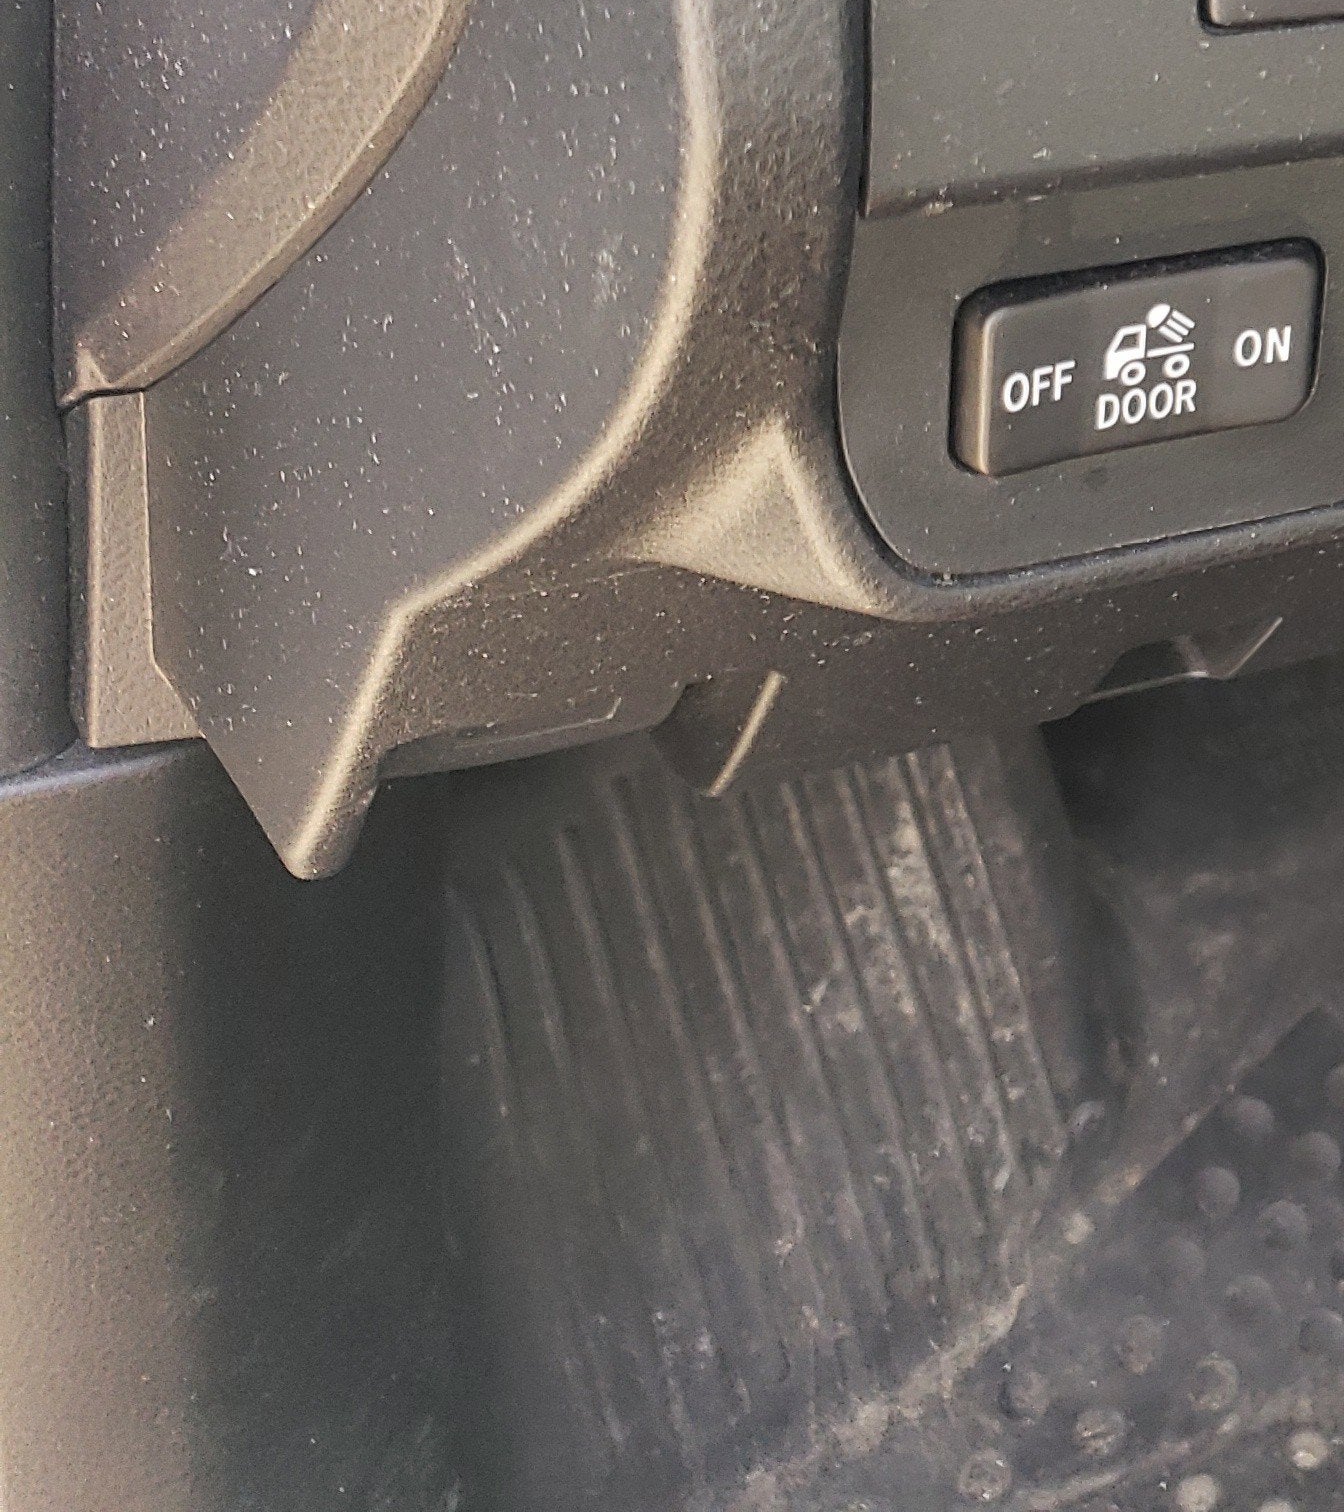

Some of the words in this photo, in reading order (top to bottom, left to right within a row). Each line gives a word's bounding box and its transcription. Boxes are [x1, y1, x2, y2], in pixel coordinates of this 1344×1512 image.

[1234, 325, 1292, 368] ON
[1002, 360, 1076, 414] OFF
[1095, 379, 1197, 430] DOOR
